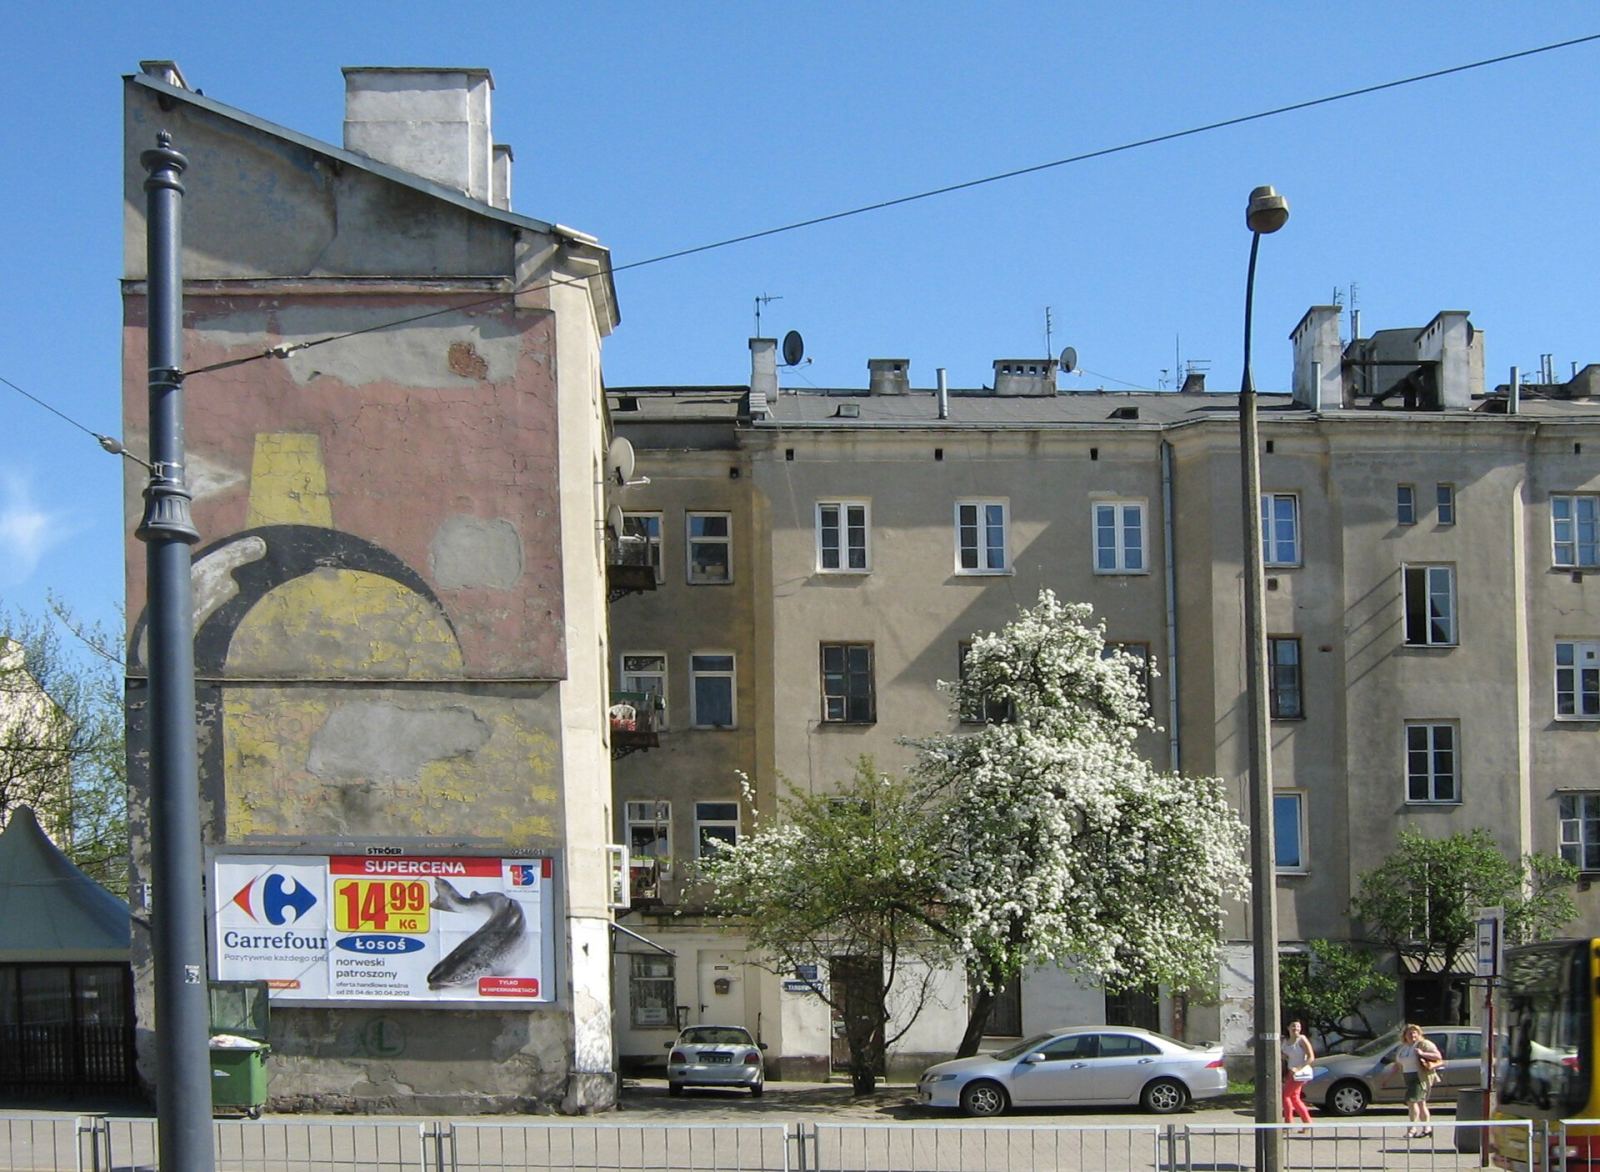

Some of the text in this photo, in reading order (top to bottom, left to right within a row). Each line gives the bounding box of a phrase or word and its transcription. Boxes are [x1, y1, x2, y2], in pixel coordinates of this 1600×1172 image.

[367, 847, 402, 855] STRÖER
[364, 860, 466, 875] SUPERCENA
[339, 882, 425, 930] 14 99
[399, 919, 417, 929] KG
[224, 931, 328, 949] Carrefour
[355, 938, 406, 950] Łosoś
[224, 953, 272, 962] Pozytywnie
[273, 953, 310, 962] każdego
[336, 957, 385, 967] norweski
[336, 969, 398, 981] patroszony
